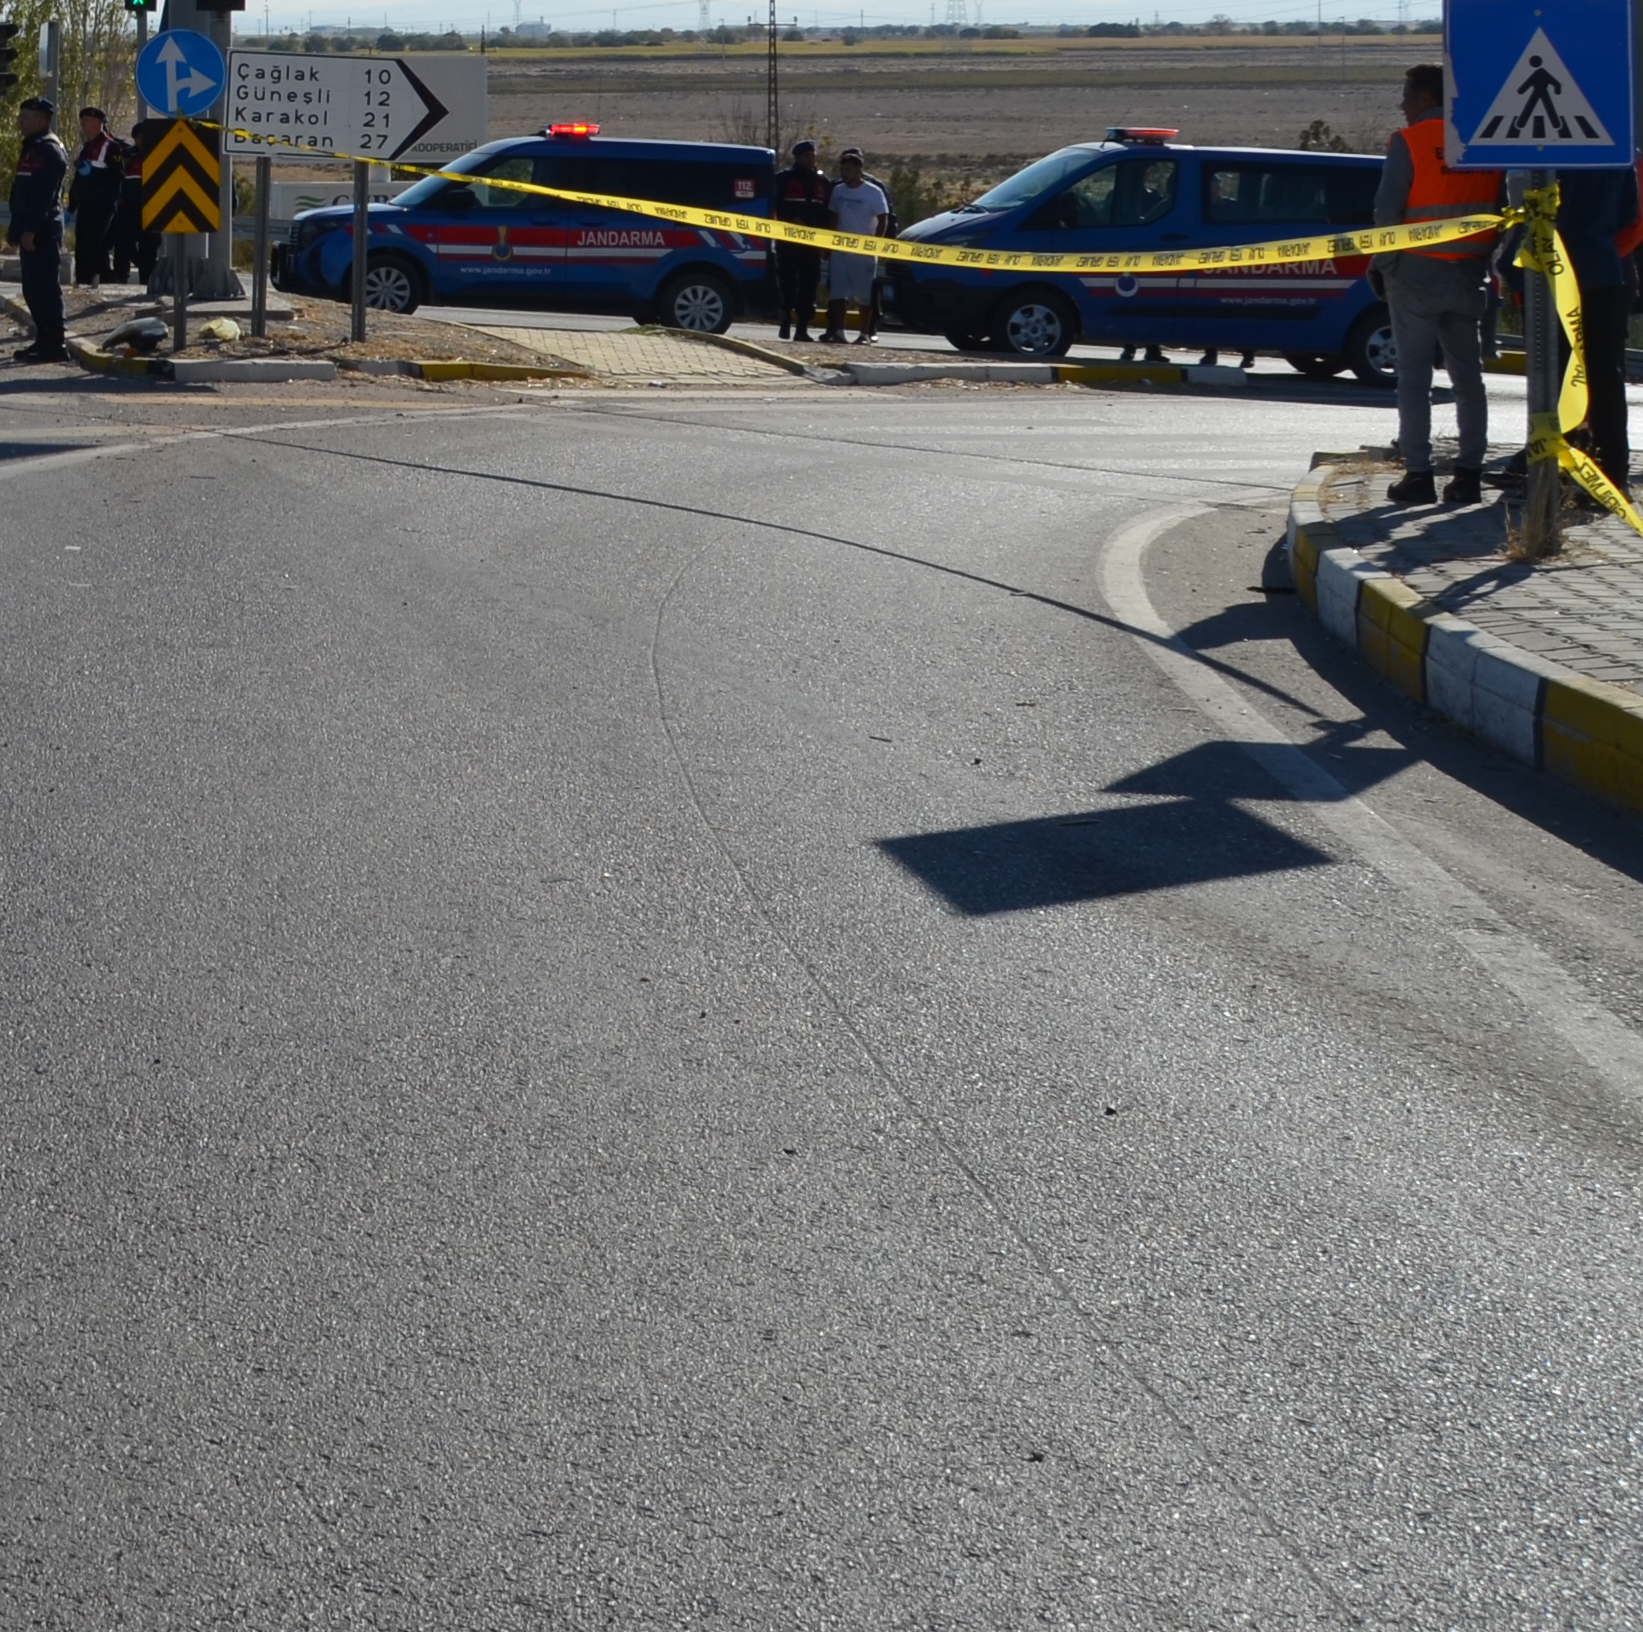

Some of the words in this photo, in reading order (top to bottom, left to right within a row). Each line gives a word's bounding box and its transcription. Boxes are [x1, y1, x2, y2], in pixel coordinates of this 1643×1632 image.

[237, 63, 320, 84] Çağlak
[365, 69, 392, 85] 10
[236, 85, 330, 105] Güneşli
[364, 91, 391, 107] 12
[234, 106, 328, 125] Karakol
[363, 112, 390, 128] 21
[360, 134, 389, 150] 27
[737, 181, 753, 190] 112
[577, 230, 666, 247] JANDARMA
[460, 266, 552, 276] www.jandarma.gov.tr
[1220, 295, 1317, 306] www.jandarma.gov.tr
